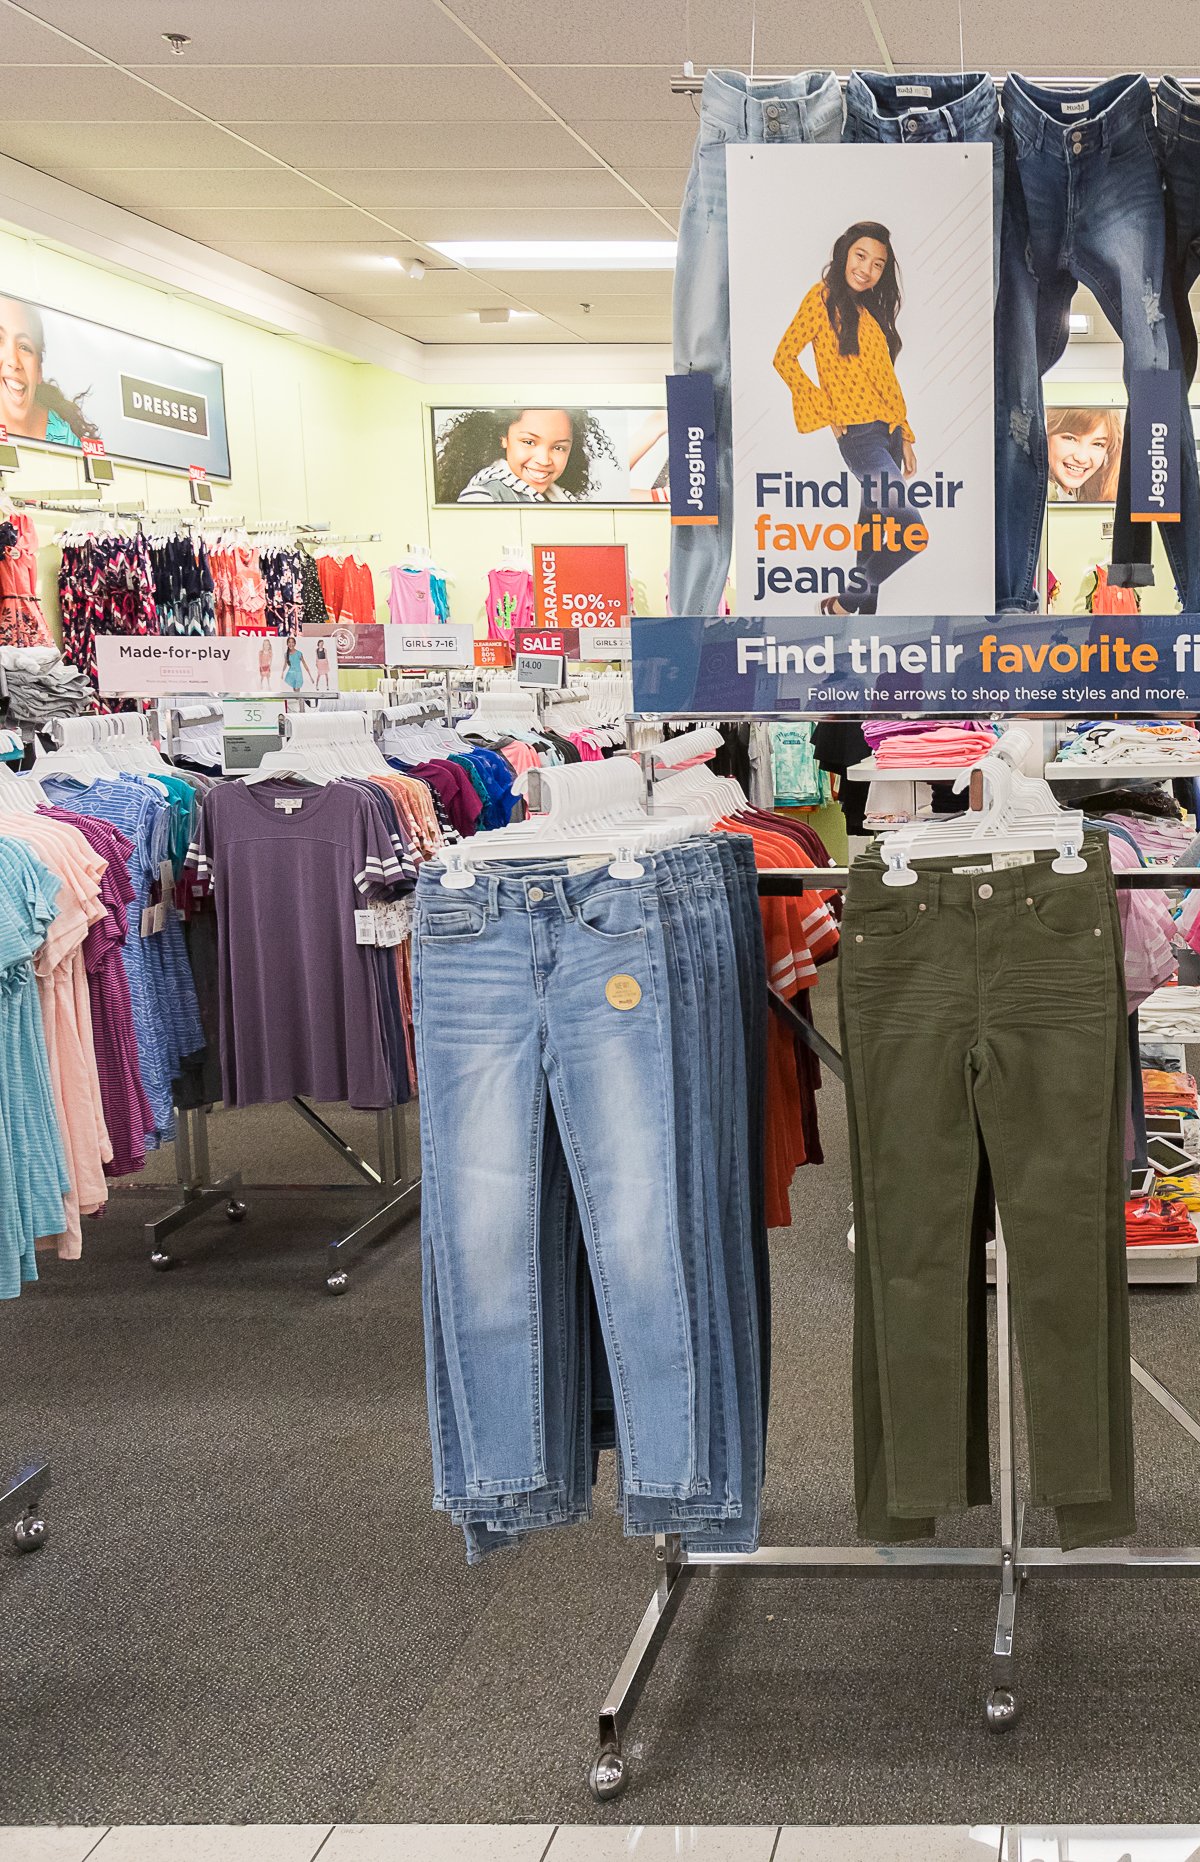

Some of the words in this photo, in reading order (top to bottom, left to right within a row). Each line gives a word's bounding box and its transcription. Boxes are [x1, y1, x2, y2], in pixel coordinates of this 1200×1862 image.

[132, 391, 198, 424] DRESSES
[83, 440, 105, 456] SALE
[687, 426, 705, 511] Jegging
[1148, 422, 1168, 508] Jegging
[189, 468, 206, 480] SALE
[756, 472, 848, 508] Find
[861, 472, 964, 508] their
[754, 514, 930, 552] favorite
[753, 557, 879, 601] jeans.
[543, 551, 556, 628] EARANCE
[562, 594, 605, 610] 50%
[607, 600, 621, 608] TO
[570, 611, 616, 628] 80%
[405, 640, 434, 649] GIRLS
[435, 640, 454, 648] 7-16
[522, 637, 562, 651] SALE
[119, 645, 231, 661] Made-for-play
[736, 635, 835, 674] Find
[849, 635, 963, 674] their
[979, 634, 1159, 673] favorite
[521, 660, 542, 670] 14.00
[807, 688, 859, 701] Follow
[864, 688, 890, 701] the
[893, 690, 947, 701] arrows
[950, 688, 968, 701] to
[972, 687, 1010, 704] shop
[1014, 686, 1058, 700] these
[1060, 686, 1108, 703] styles
[1110, 686, 1142, 700] and
[1145, 689, 1189, 700] more.
[244, 709, 262, 722] 35
